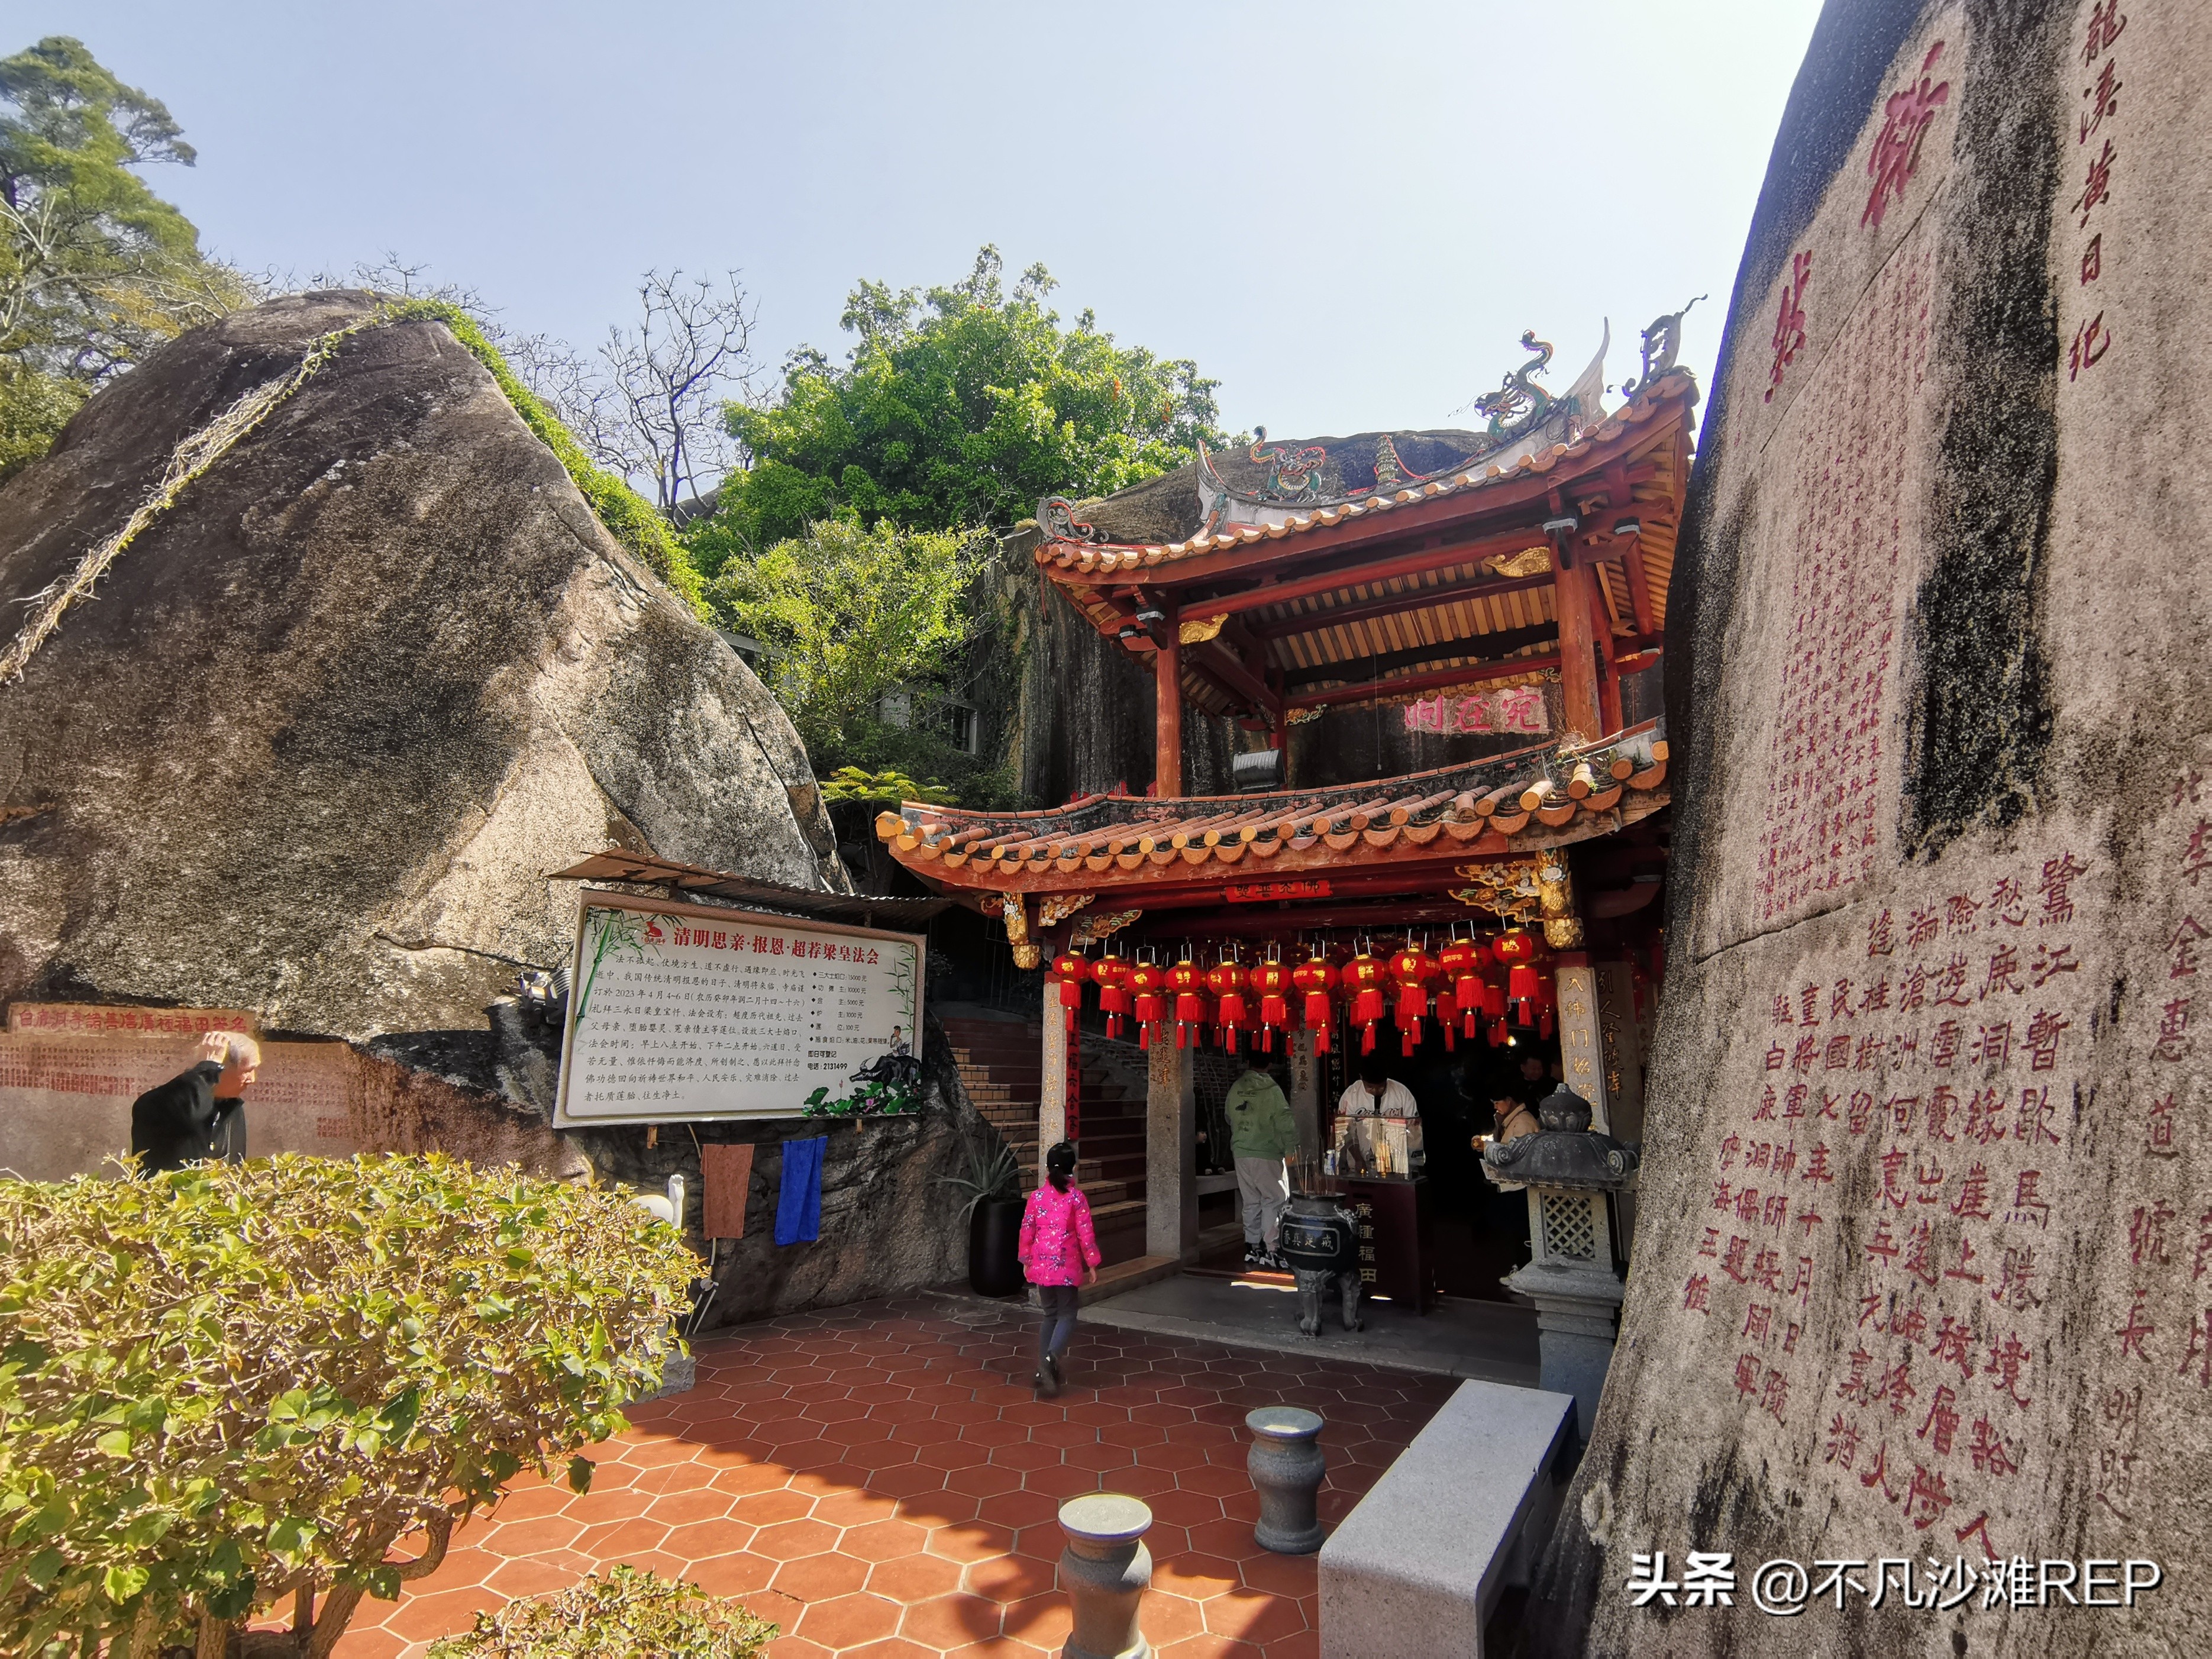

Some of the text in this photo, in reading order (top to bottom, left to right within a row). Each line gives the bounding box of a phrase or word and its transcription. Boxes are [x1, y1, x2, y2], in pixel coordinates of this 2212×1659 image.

[674, 927, 879, 965] 清明思亲·报恩·超荐梁皇法会
